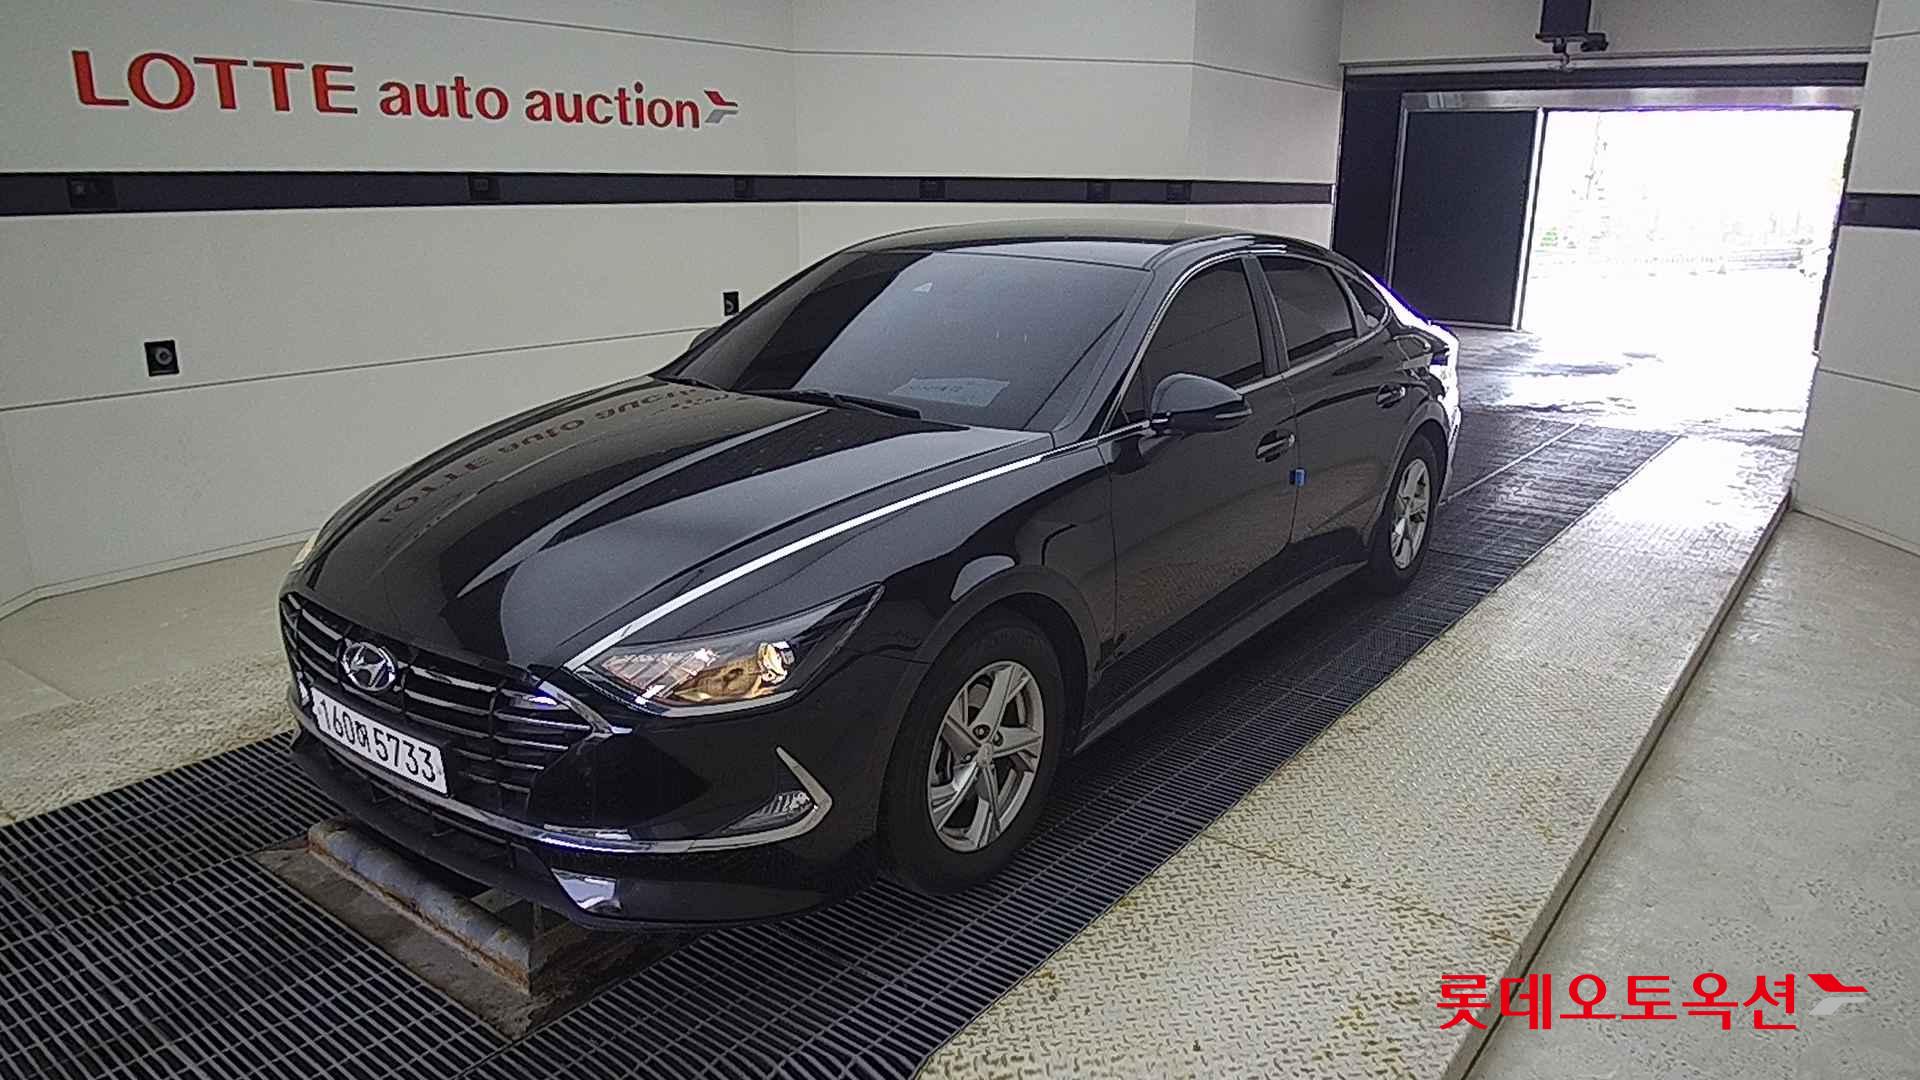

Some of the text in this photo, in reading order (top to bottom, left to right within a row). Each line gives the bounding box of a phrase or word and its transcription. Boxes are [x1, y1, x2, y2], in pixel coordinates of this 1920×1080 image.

[72, 50, 700, 129] LOTTE auto auction
